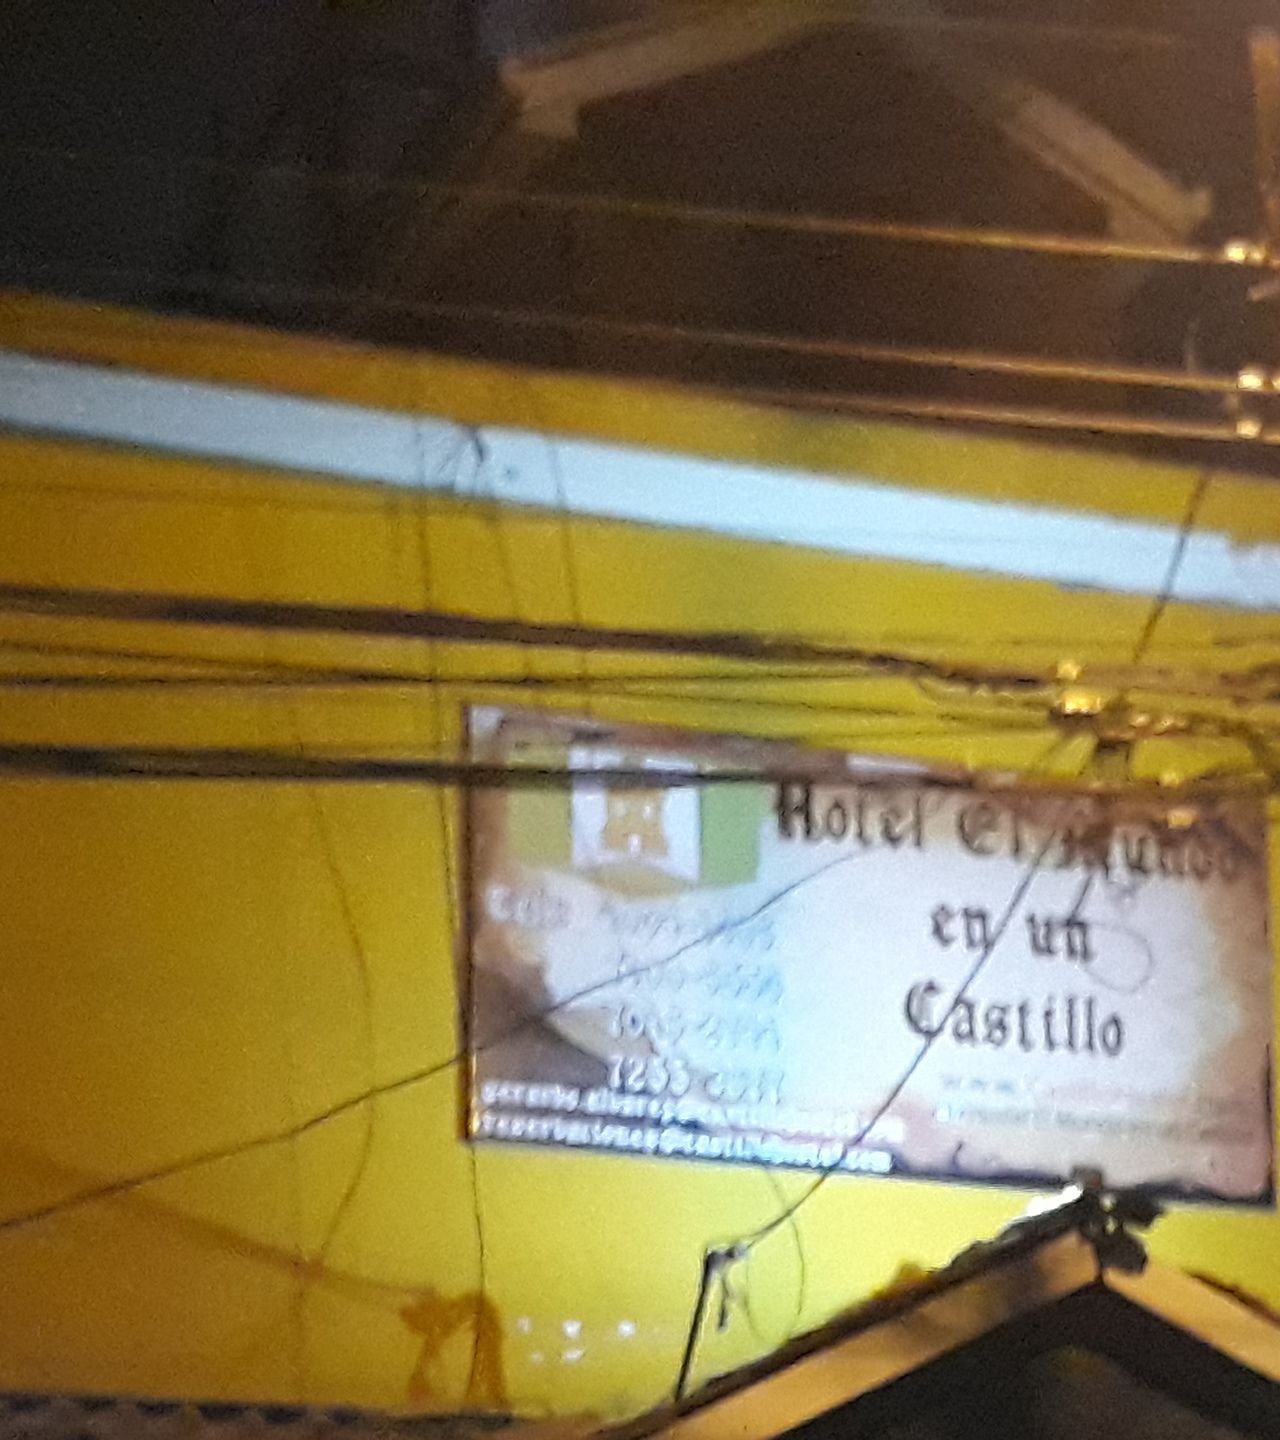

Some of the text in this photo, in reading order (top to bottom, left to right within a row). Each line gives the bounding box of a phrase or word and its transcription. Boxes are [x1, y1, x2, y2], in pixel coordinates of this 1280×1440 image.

[773, 779, 923, 846] Hotel
[931, 903, 1094, 964] en un
[904, 979, 1126, 1056] Castillo
